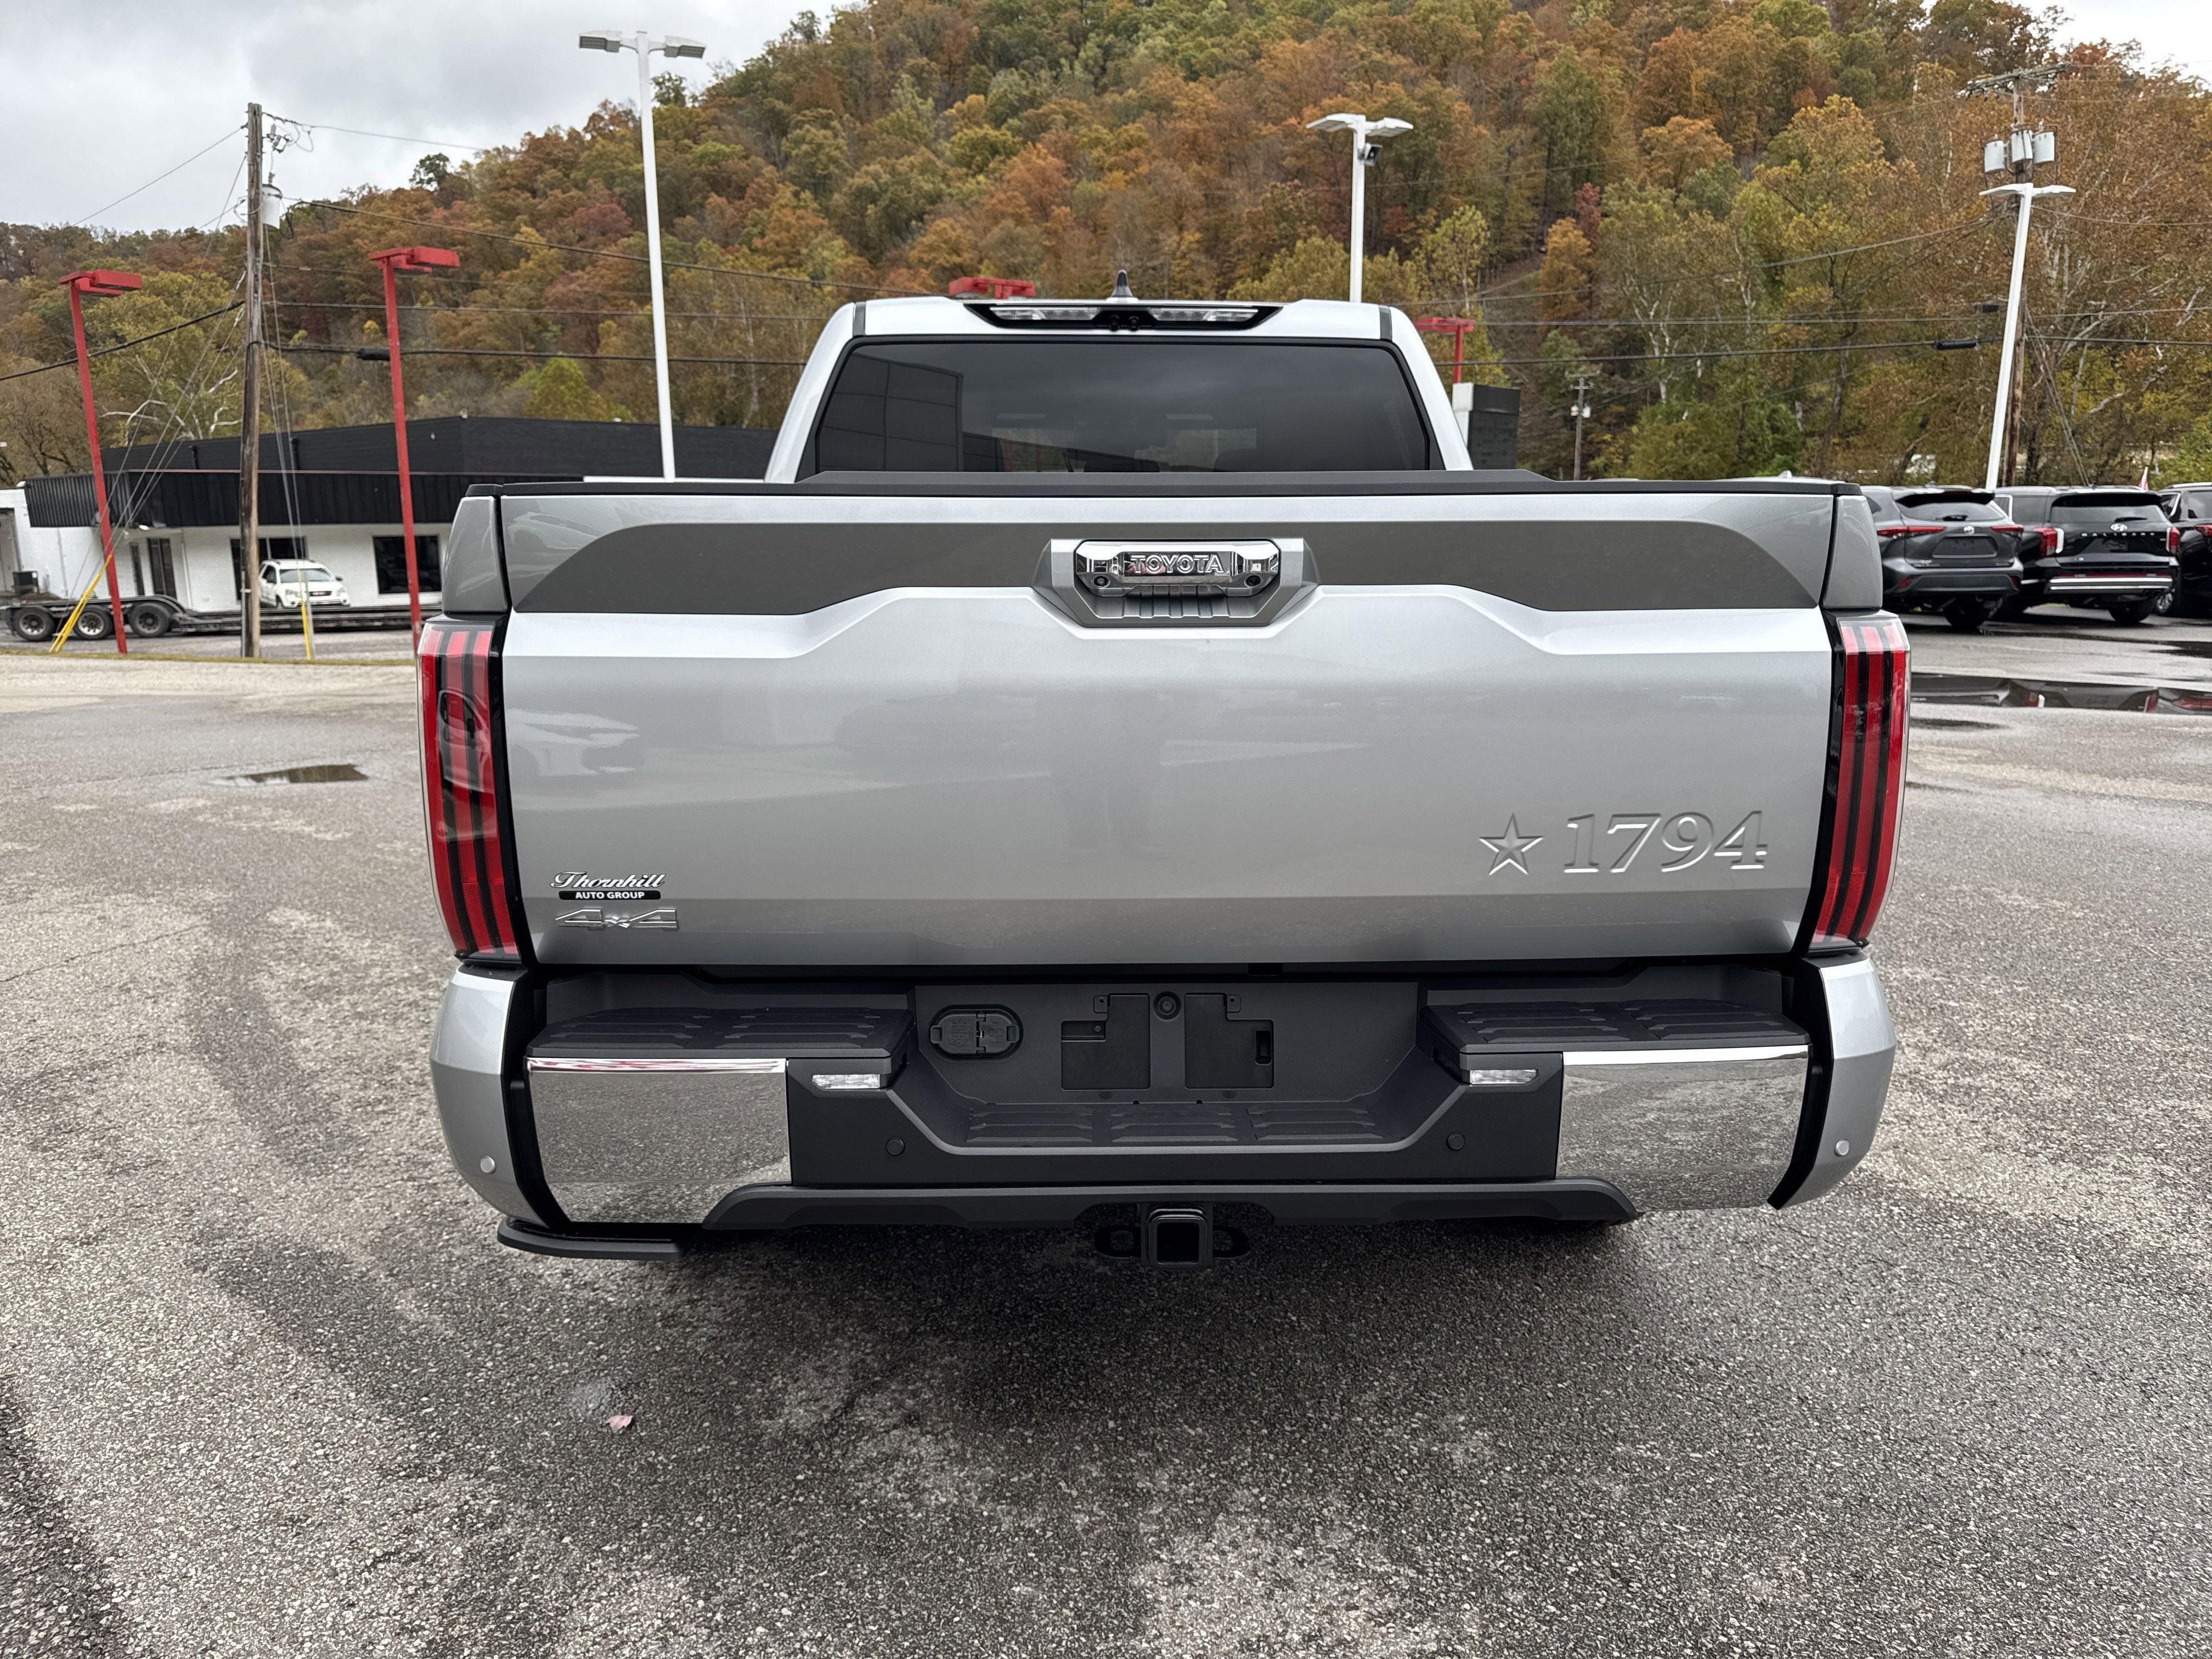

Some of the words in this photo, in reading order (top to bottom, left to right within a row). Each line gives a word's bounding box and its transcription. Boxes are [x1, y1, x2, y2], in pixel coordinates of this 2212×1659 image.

[1131, 554, 1224, 573] TOYOTA
[1564, 810, 1768, 873] 1794
[550, 871, 667, 888] Thornhill
